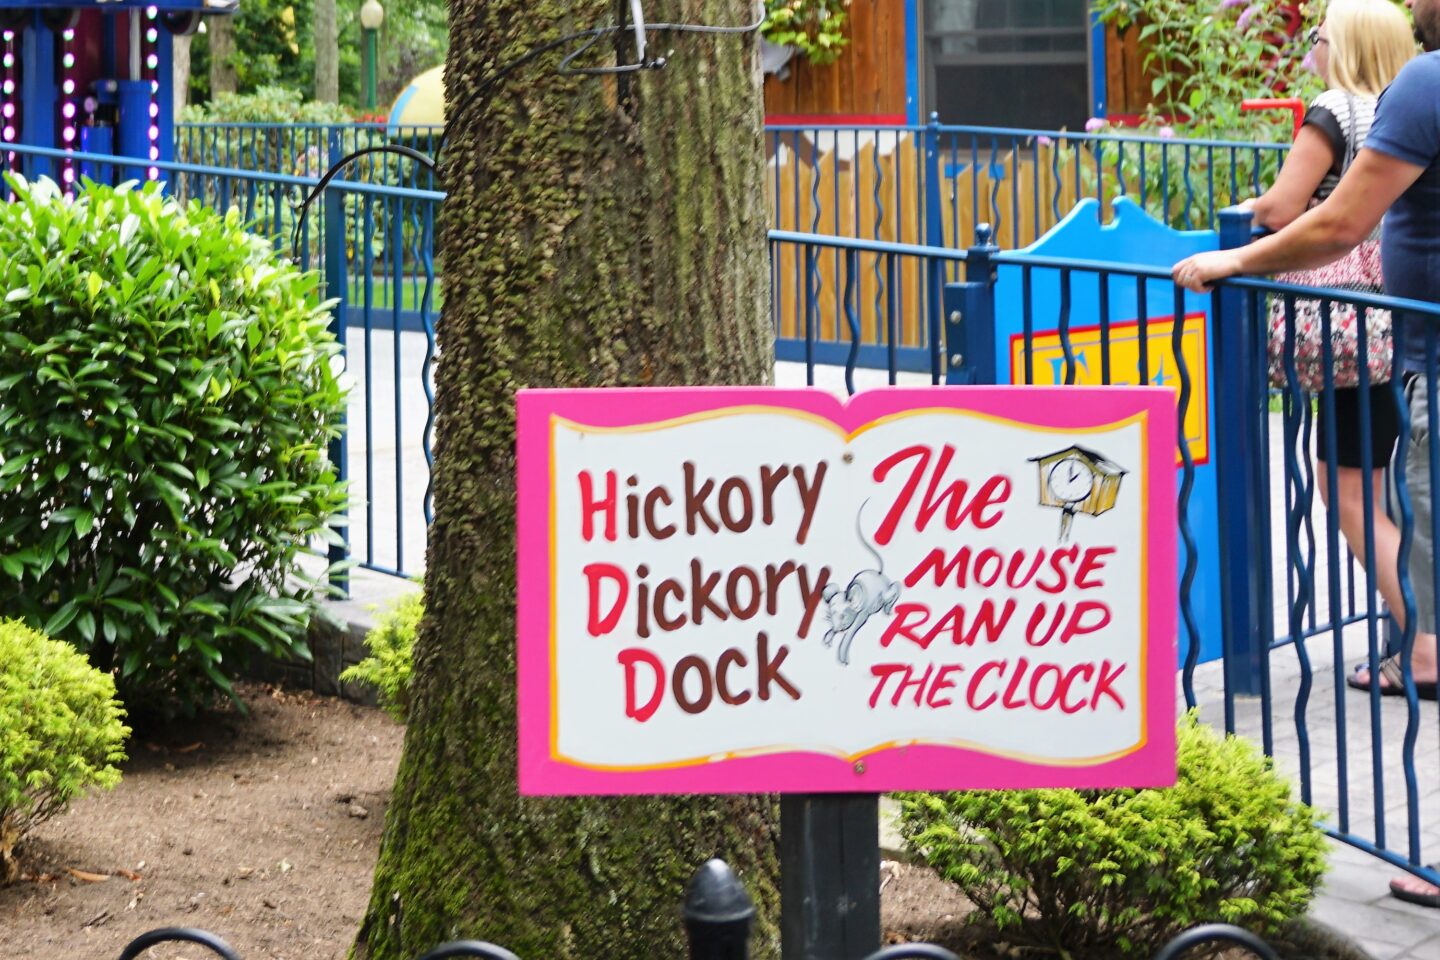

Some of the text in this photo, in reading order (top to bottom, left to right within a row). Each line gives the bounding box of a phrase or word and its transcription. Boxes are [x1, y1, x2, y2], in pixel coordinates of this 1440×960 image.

[577, 461, 827, 545] Hickory
[872, 442, 1012, 546] The
[583, 557, 830, 639] Dickory
[904, 543, 1117, 593] MOUSE
[880, 597, 1111, 650] RAN UP
[618, 632, 801, 723] Dock
[868, 656, 1127, 714] THE CLOCK
